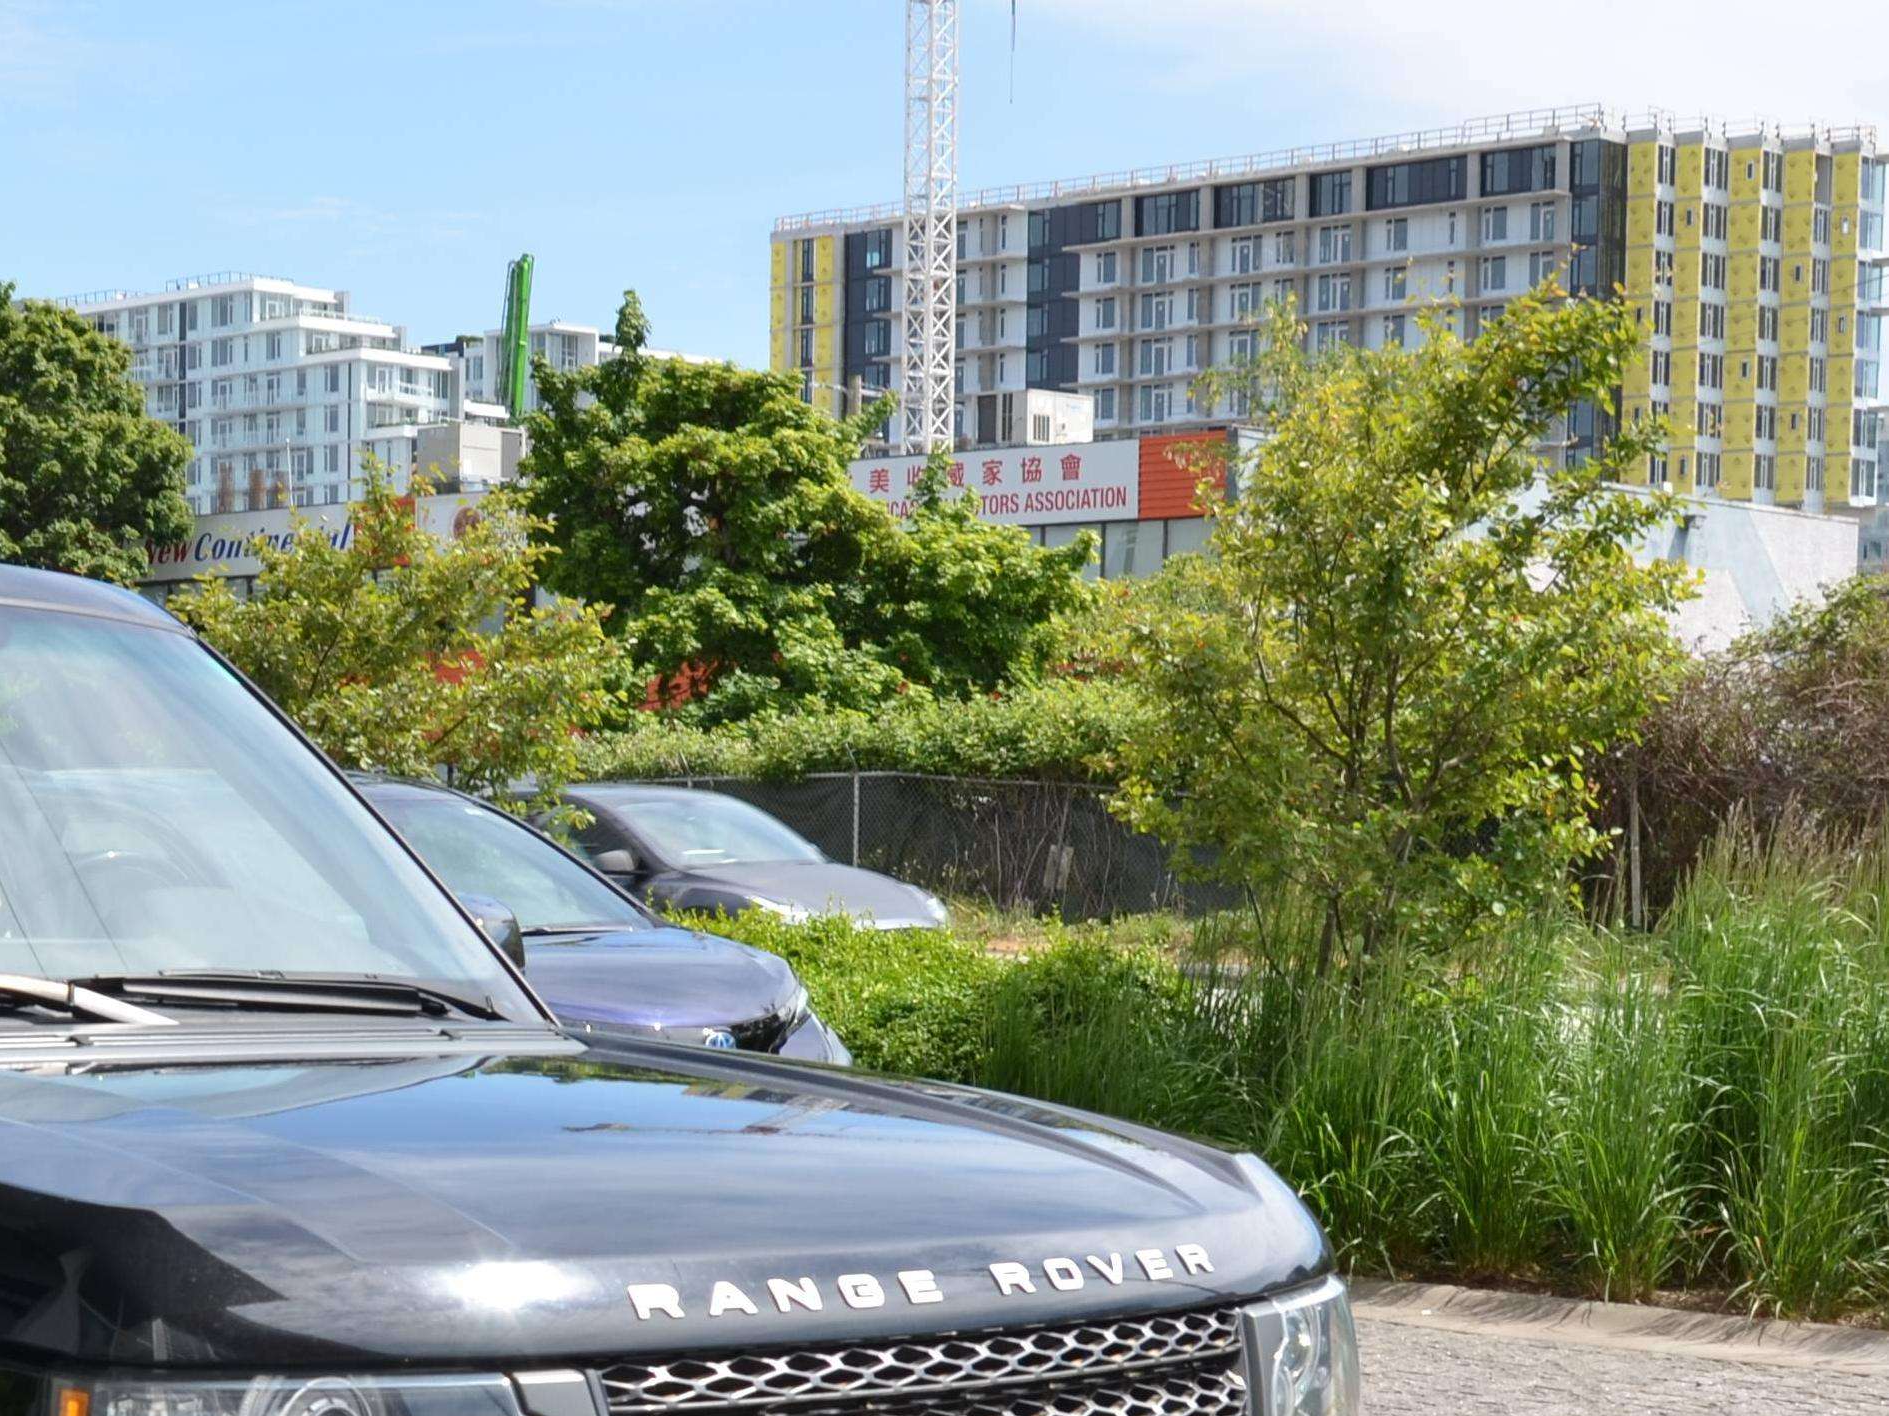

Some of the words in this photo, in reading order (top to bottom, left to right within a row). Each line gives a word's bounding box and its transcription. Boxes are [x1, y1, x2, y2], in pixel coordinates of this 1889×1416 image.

[1023, 486, 1128, 513] ASSOCIATION
[627, 1268, 944, 1320] RANGE
[988, 1242, 1215, 1297] ROVER
